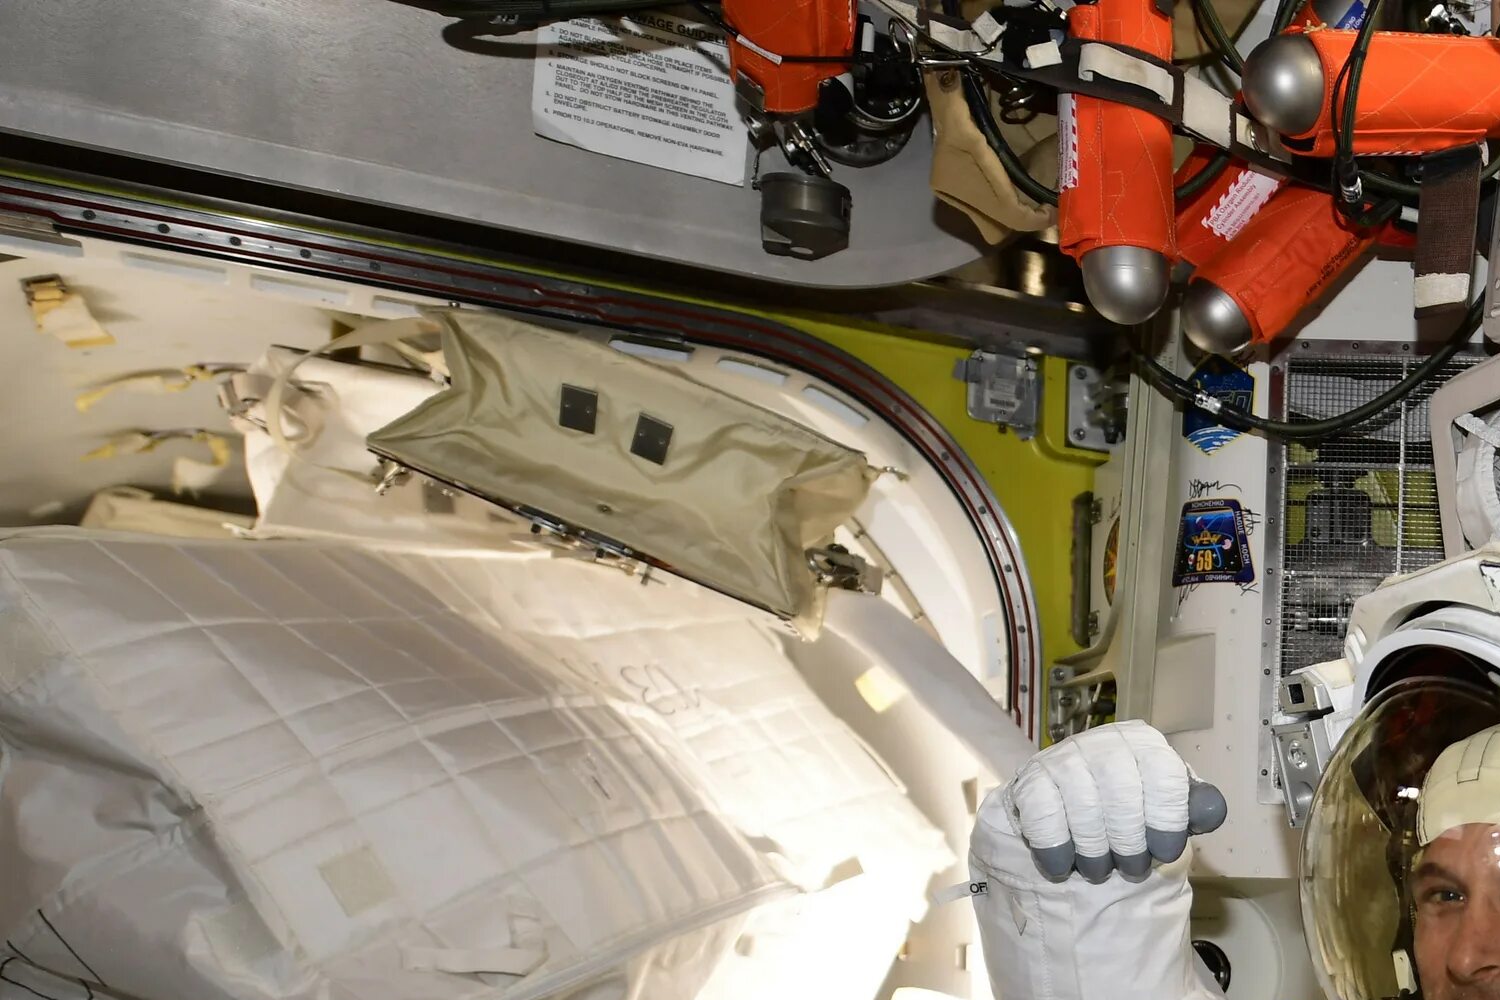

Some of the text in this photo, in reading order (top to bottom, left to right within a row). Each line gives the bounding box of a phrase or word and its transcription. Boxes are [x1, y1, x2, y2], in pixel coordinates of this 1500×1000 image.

[589, 60, 615, 71] SHOULD
[615, 67, 628, 75] NOT
[629, 71, 650, 80] BLOCK
[651, 76, 680, 88] SCREENS
[646, 58, 663, 66] HOSE
[664, 62, 693, 74] STRAIGHT
[673, 59, 693, 68] PLACE
[694, 65, 712, 73] ITEMS
[555, 63, 586, 75] MAINTAIN
[596, 74, 622, 84] OXYGEN
[623, 81, 649, 91] VENTING
[650, 88, 678, 99] PATHWAY
[678, 95, 701, 105] BEHIND
[555, 69, 589, 82] CLOSEOUT
[619, 85, 637, 94] FROM
[690, 104, 727, 117] REGULATOR
[578, 98, 611, 111] OBSTRUCT
[613, 107, 640, 118] BATTERY
[641, 114, 670, 126] STOWAGE
[671, 122, 702, 134] ASSEMBLY
[702, 130, 721, 138] DOOR
[604, 93, 621, 102] STOW
[623, 98, 657, 111] HARDWARE
[680, 113, 705, 123] VENTING
[606, 88, 622, 96] HALF
[646, 98, 663, 106] MESH
[664, 103, 688, 113] SCREEN
[708, 114, 729, 123] CLOTH
[552, 109, 571, 118] PRIOR
[636, 130, 661, 141] REMOVE
[1235, 510, 1244, 534] HAGUE
[1196, 550, 1212, 571] 59
[1241, 544, 1250, 564] KOCH
